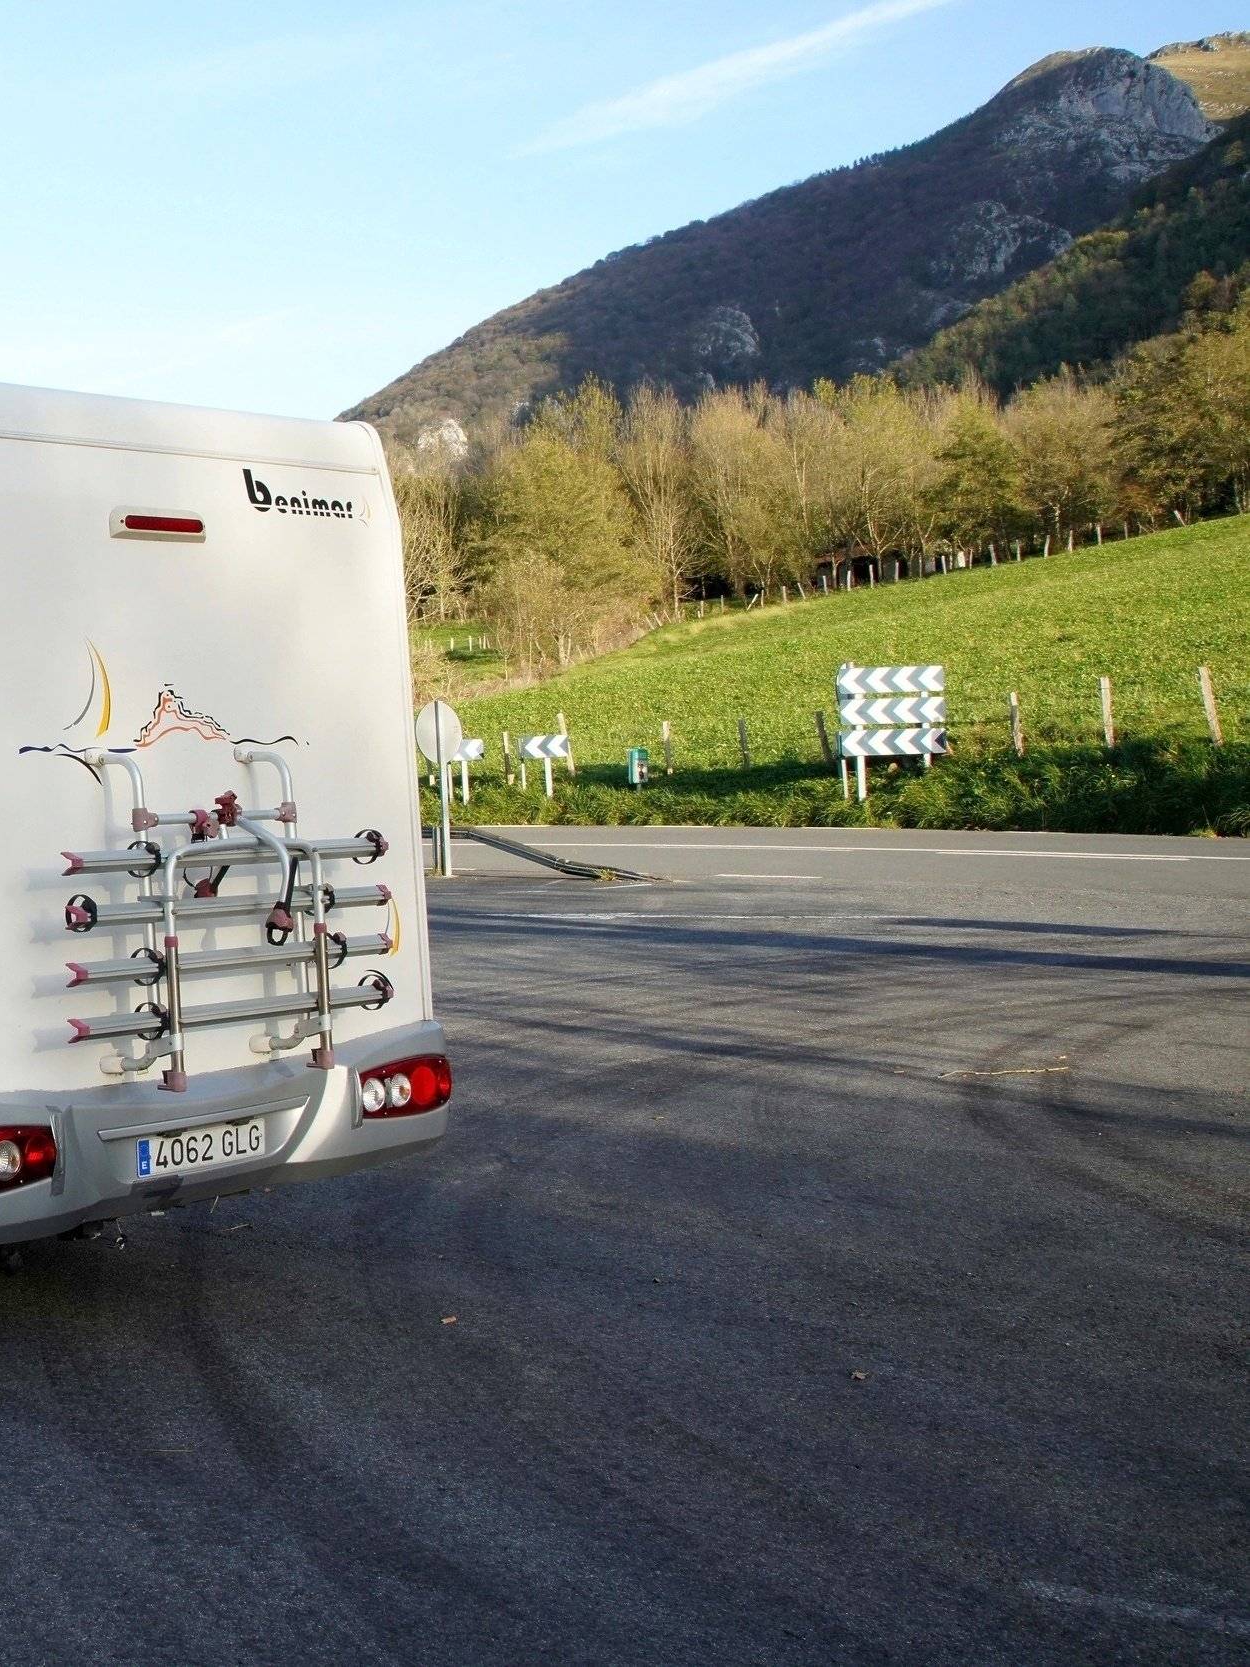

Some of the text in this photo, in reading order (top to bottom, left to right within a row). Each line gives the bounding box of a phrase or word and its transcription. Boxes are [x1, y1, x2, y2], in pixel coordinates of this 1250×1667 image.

[242, 468, 353, 519] benimar
[141, 1160, 148, 1170] E
[155, 1125, 260, 1168] 4062 GLG
